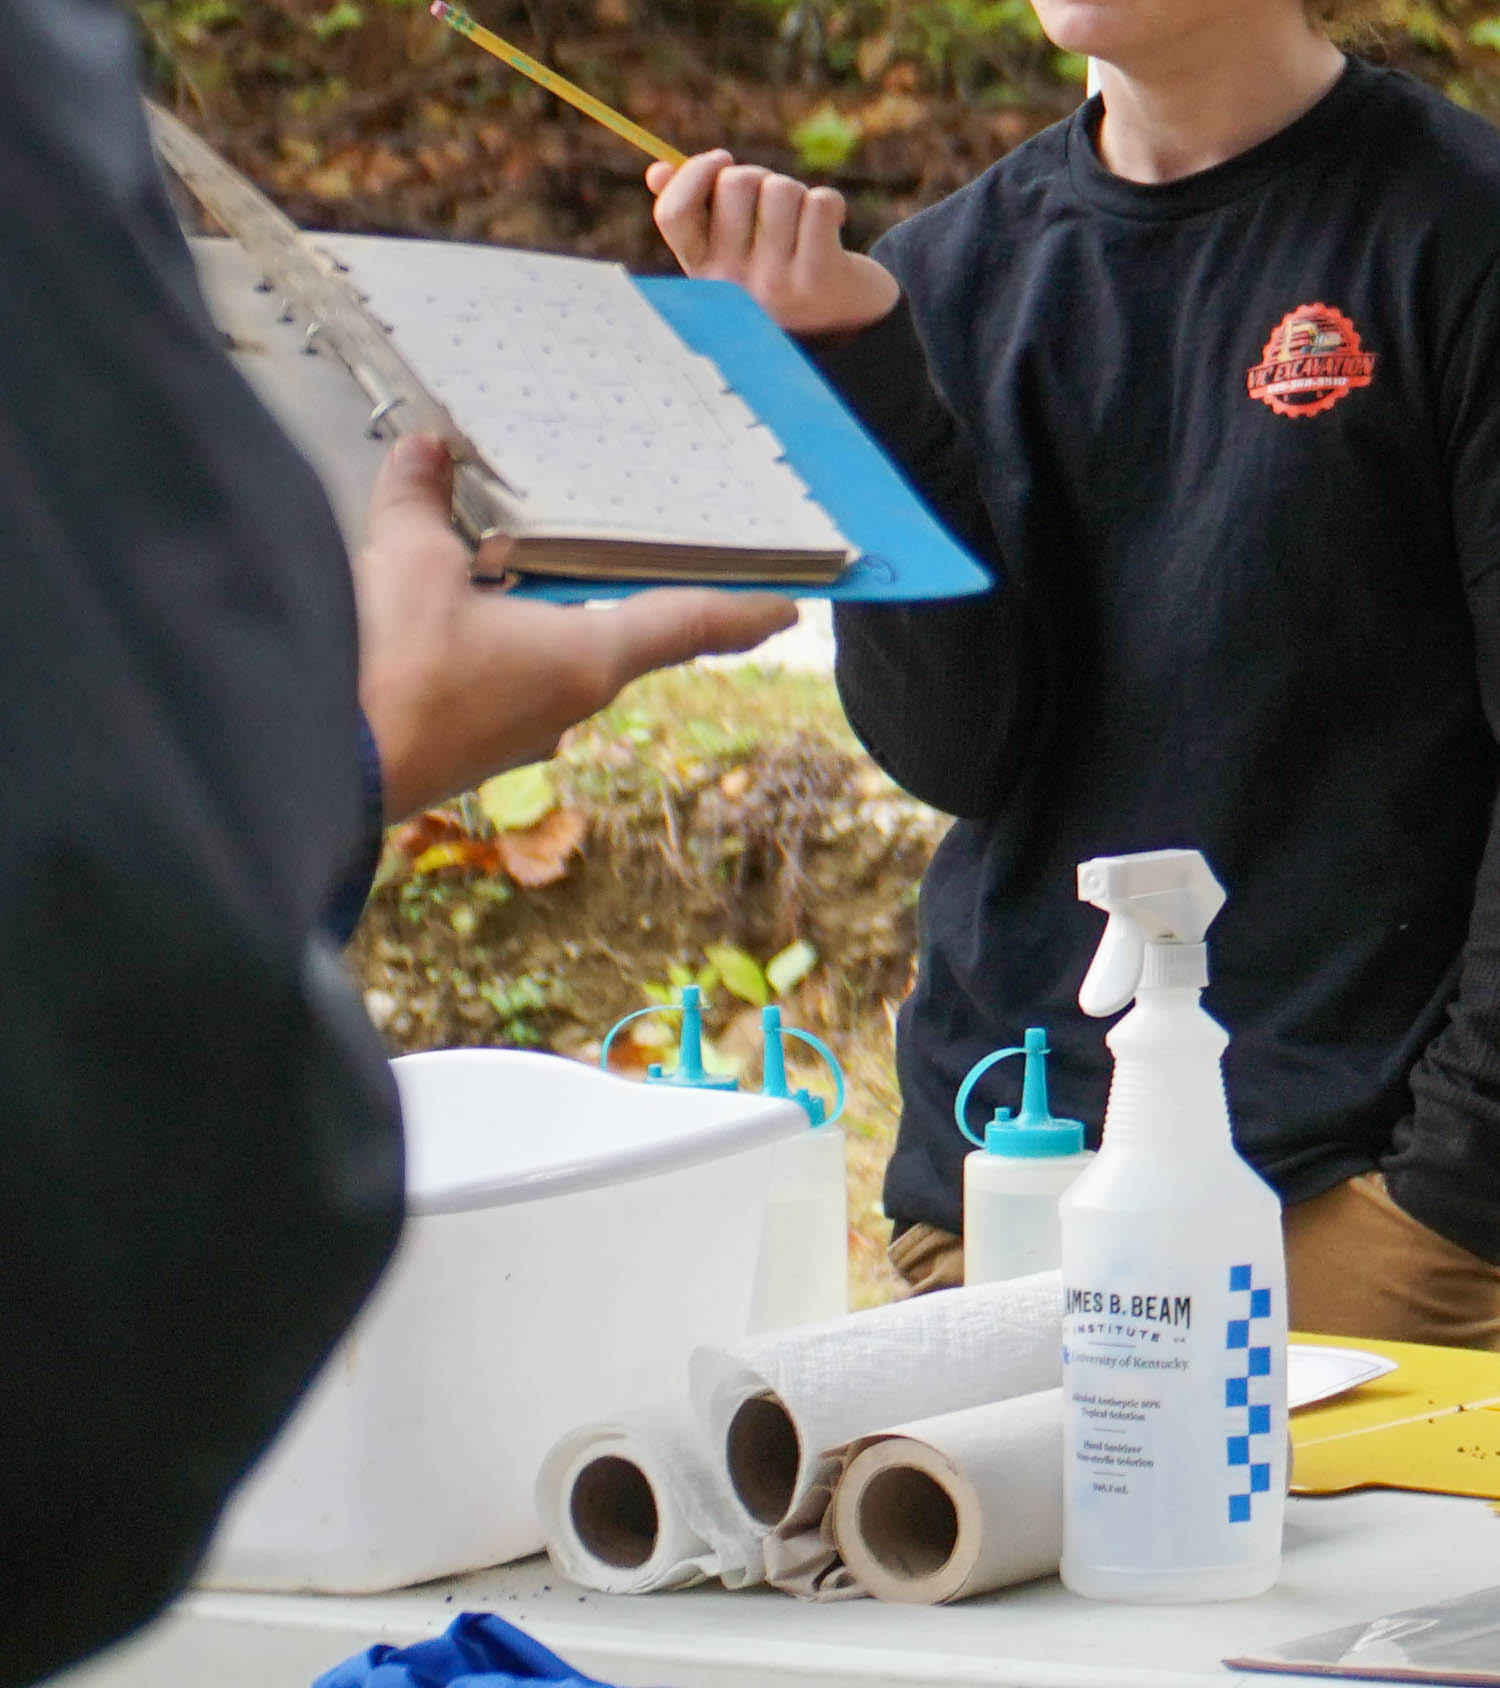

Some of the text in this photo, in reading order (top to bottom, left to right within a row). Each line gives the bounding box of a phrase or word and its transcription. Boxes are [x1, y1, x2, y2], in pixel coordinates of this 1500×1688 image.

[1110, 1293, 1126, 1316] B.
[1131, 1295, 1192, 1330] BEAM
[1073, 1323, 1162, 1343] INSTITUTE
[1120, 1354, 1133, 1368] of
